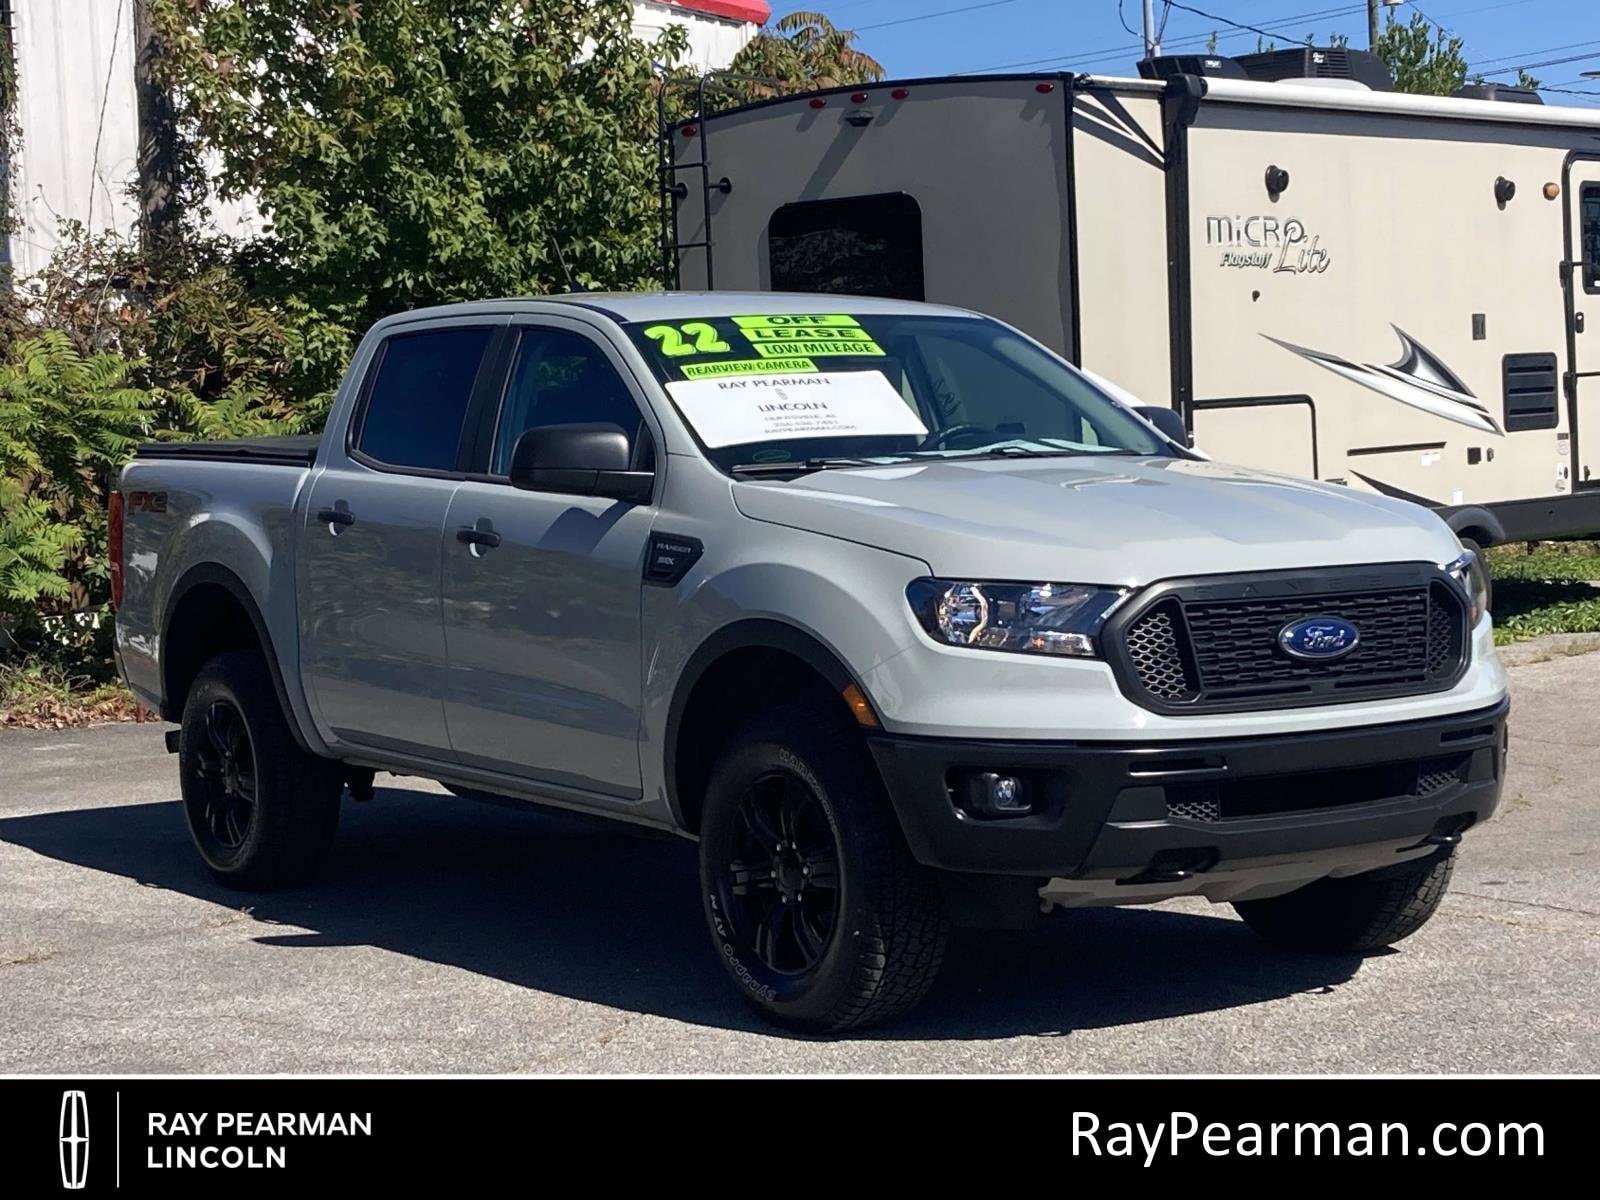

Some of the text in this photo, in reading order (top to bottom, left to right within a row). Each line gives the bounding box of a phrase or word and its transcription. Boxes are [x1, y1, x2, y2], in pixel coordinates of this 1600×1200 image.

[1273, 227, 1331, 274] Lite
[766, 316, 828, 325] OFF
[644, 323, 730, 357] 22
[754, 329, 857, 338] LEASE
[763, 342, 875, 354] LOW MILEAGE
[687, 360, 811, 376] REARVIEW CAMERA
[718, 377, 831, 390] RAY PEARMAN
[758, 402, 828, 412] LINCOLN
[1303, 626, 1346, 649] Ford
